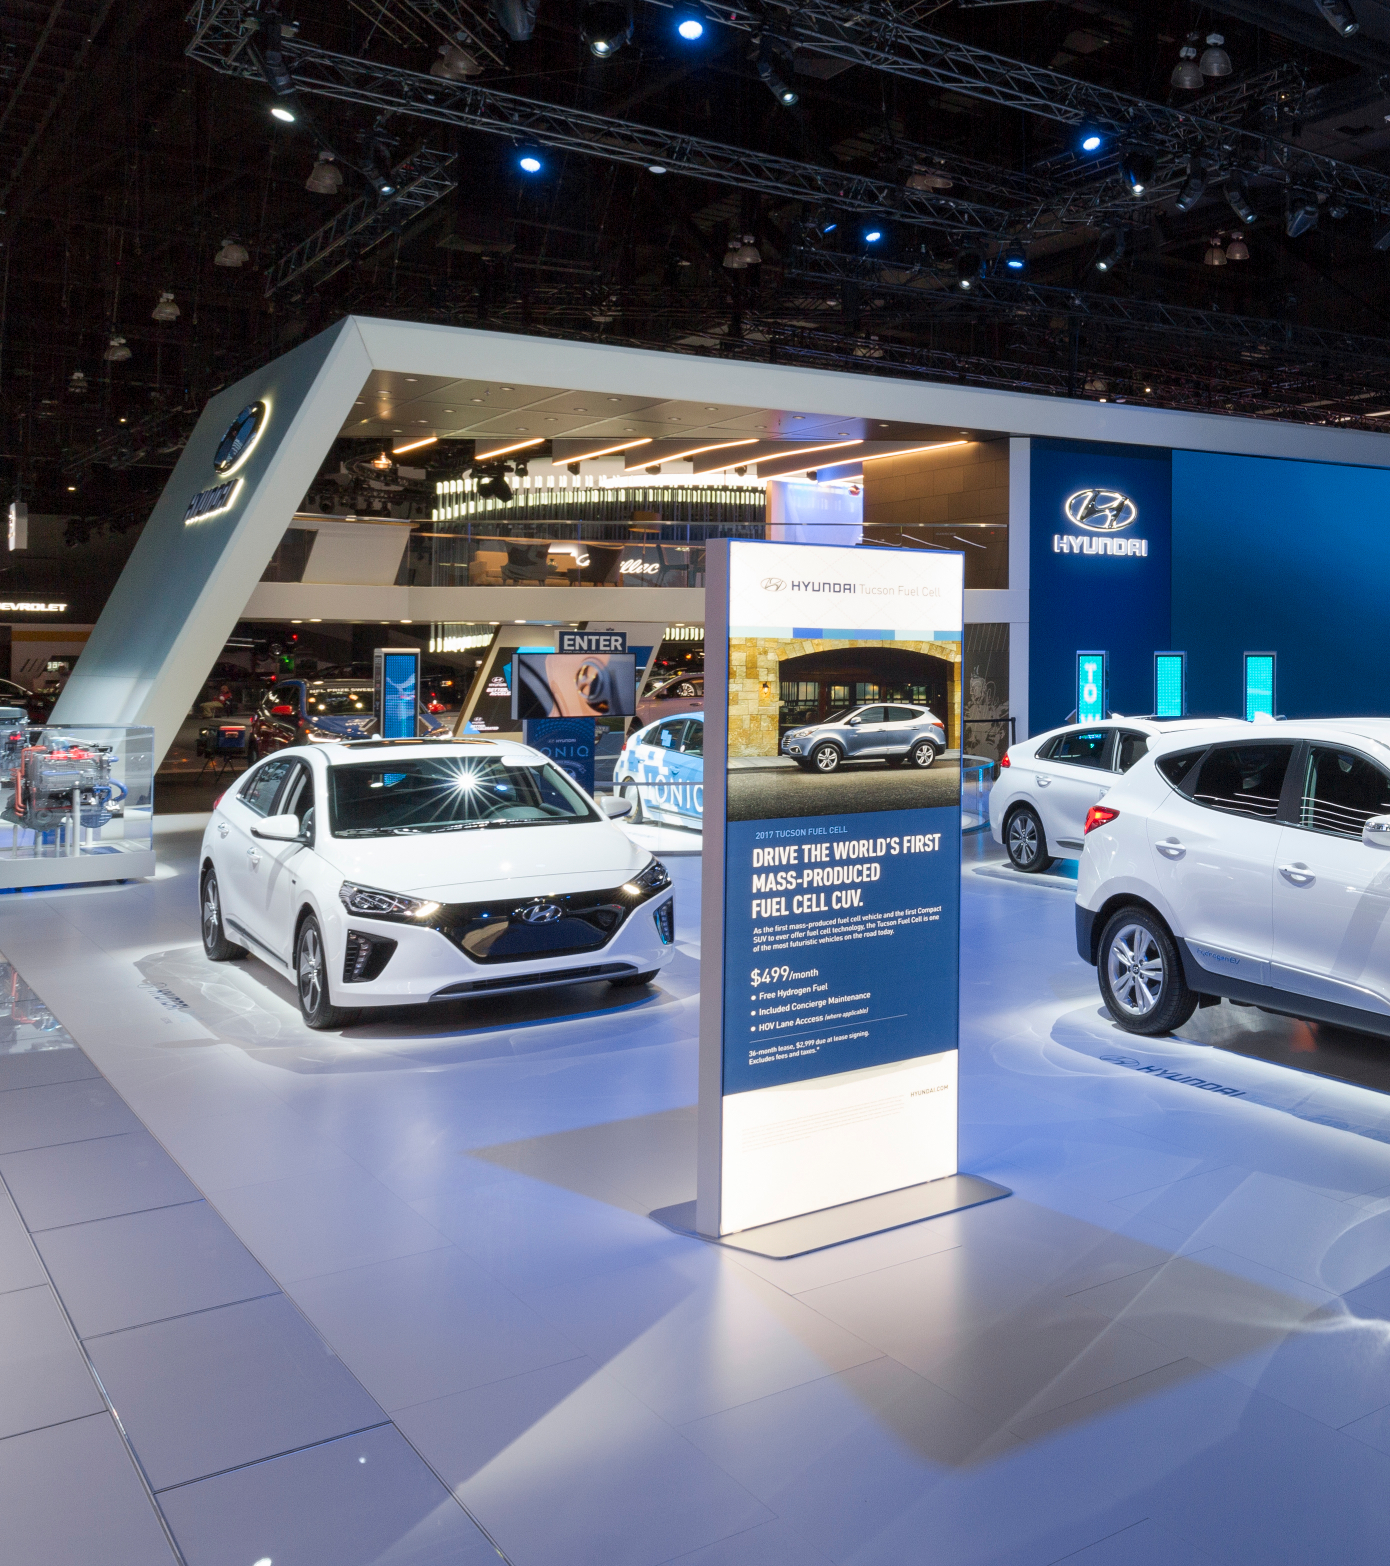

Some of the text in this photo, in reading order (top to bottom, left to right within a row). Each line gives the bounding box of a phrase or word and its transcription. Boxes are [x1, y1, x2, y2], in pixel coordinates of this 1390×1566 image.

[1054, 535, 1148, 556] HYUNDAI
[791, 581, 941, 597] HYUNDAI Tucson Fuel Cell
[0, 603, 67, 611] EVROLET
[564, 635, 622, 650] ENTER
[756, 831, 773, 839] 2017
[775, 829, 806, 837] TUCSON
[753, 834, 941, 867] DRIVE THE WORLD'S FIRST
[753, 863, 880, 893] MASS-PRODUCED
[752, 889, 863, 918] FUEL CELL CUV.
[789, 918, 836, 929] mass-produced
[918, 906, 941, 914] Compact
[790, 938, 817, 947] futuristic
[819, 935, 843, 943] vehicles
[751, 966, 818, 987] $499/month
[759, 983, 828, 1000] Free Hydrogen Fuel
[759, 992, 871, 1015] Included Concierge Maintenance
[759, 1023, 775, 1031] HOV
[776, 1020, 793, 1028] Lane
[749, 1046, 777, 1057] 36-month
[796, 1040, 814, 1049] $2,999
[849, 1031, 869, 1039] signing.
[749, 1055, 775, 1065] Excludes
[776, 1052, 788, 1060] fees
[789, 1050, 799, 1058] and
[1137, 1065, 1247, 1097] HYUNDAI
